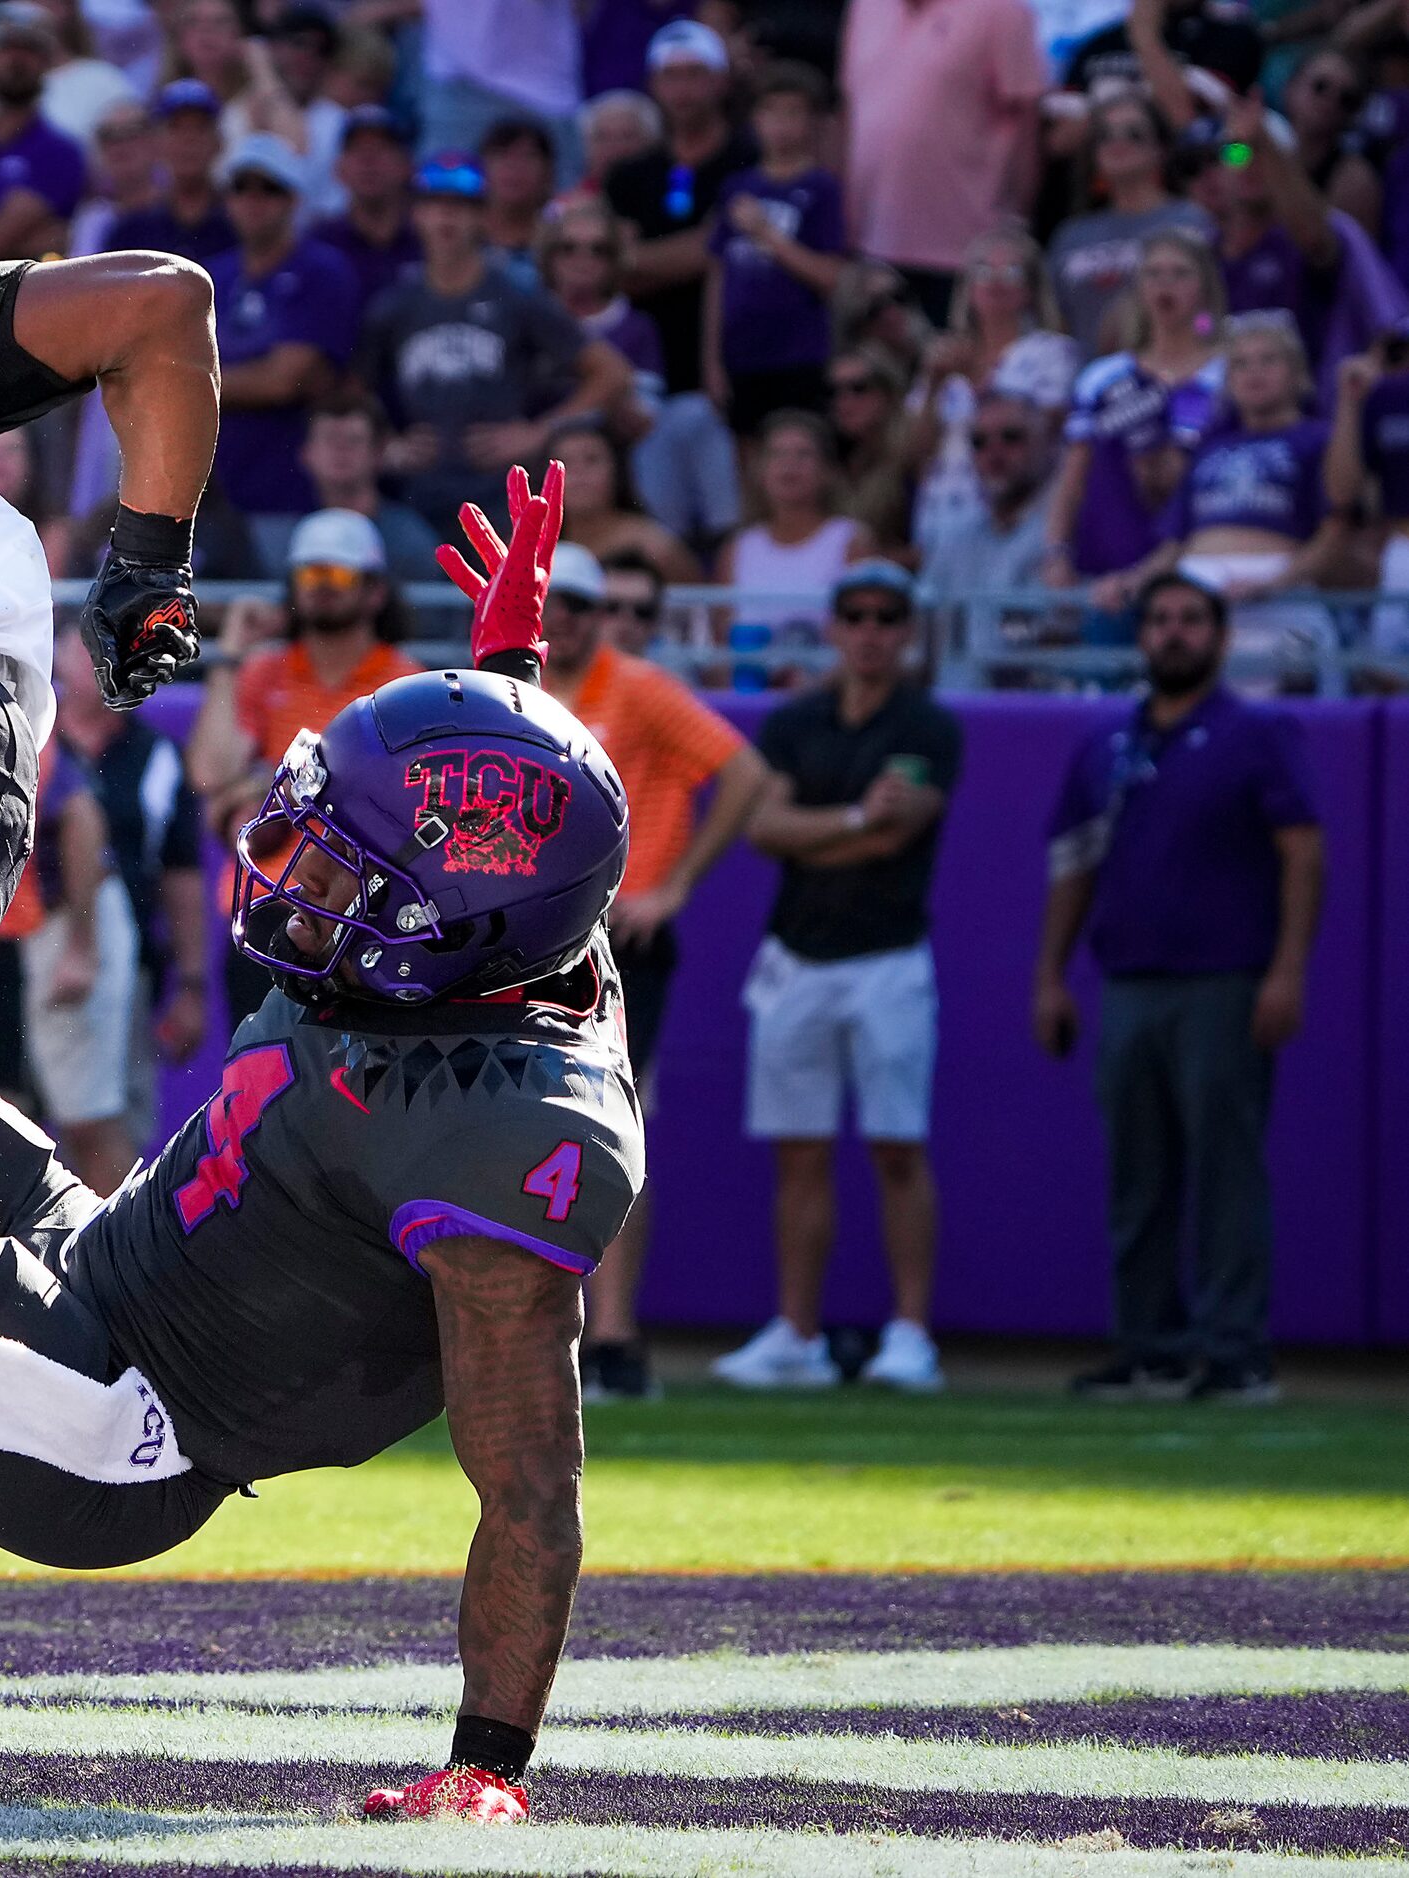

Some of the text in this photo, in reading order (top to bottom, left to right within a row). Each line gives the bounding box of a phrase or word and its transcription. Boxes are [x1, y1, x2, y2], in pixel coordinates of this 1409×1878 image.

[404, 749, 572, 844] TCU
[172, 1036, 296, 1236] 4
[520, 1138, 583, 1223] 4
[128, 1383, 166, 1469] TCU
